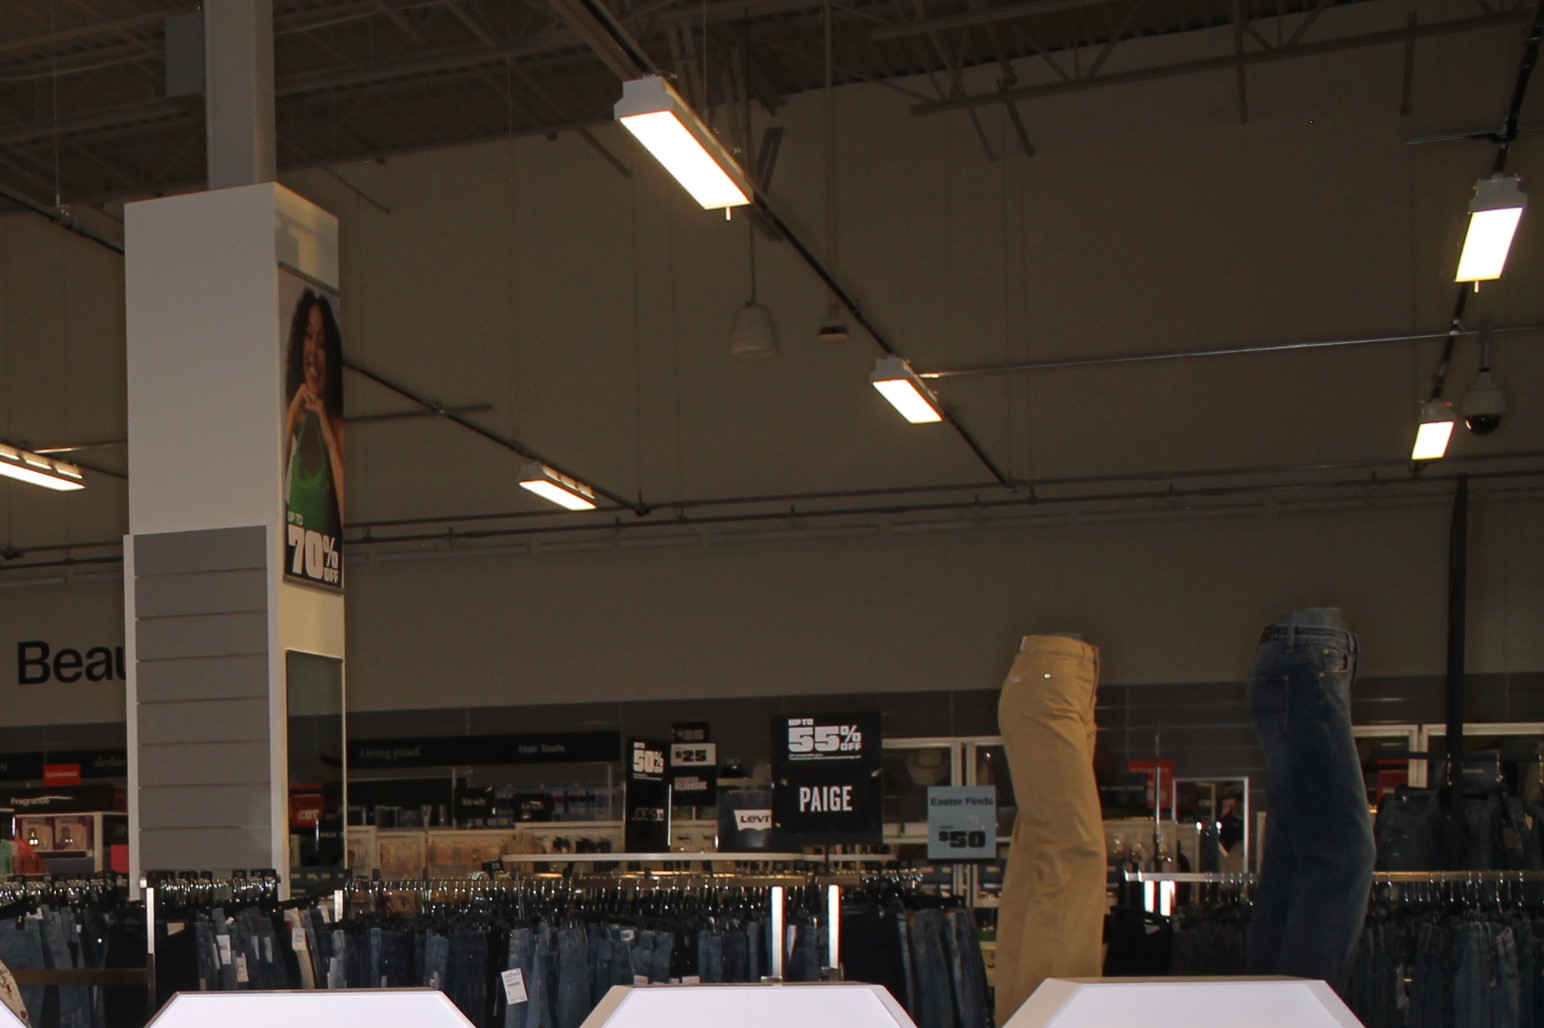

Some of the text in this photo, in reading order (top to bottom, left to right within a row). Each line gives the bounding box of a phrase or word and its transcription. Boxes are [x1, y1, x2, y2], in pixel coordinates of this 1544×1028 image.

[288, 523, 339, 579] 70%
[788, 725, 862, 753] 55%
[840, 742, 862, 751] OFF
[675, 750, 707, 762] $25
[799, 786, 853, 812] PAIGE
[930, 796, 994, 806] Easter Finds
[939, 831, 986, 848] $50
